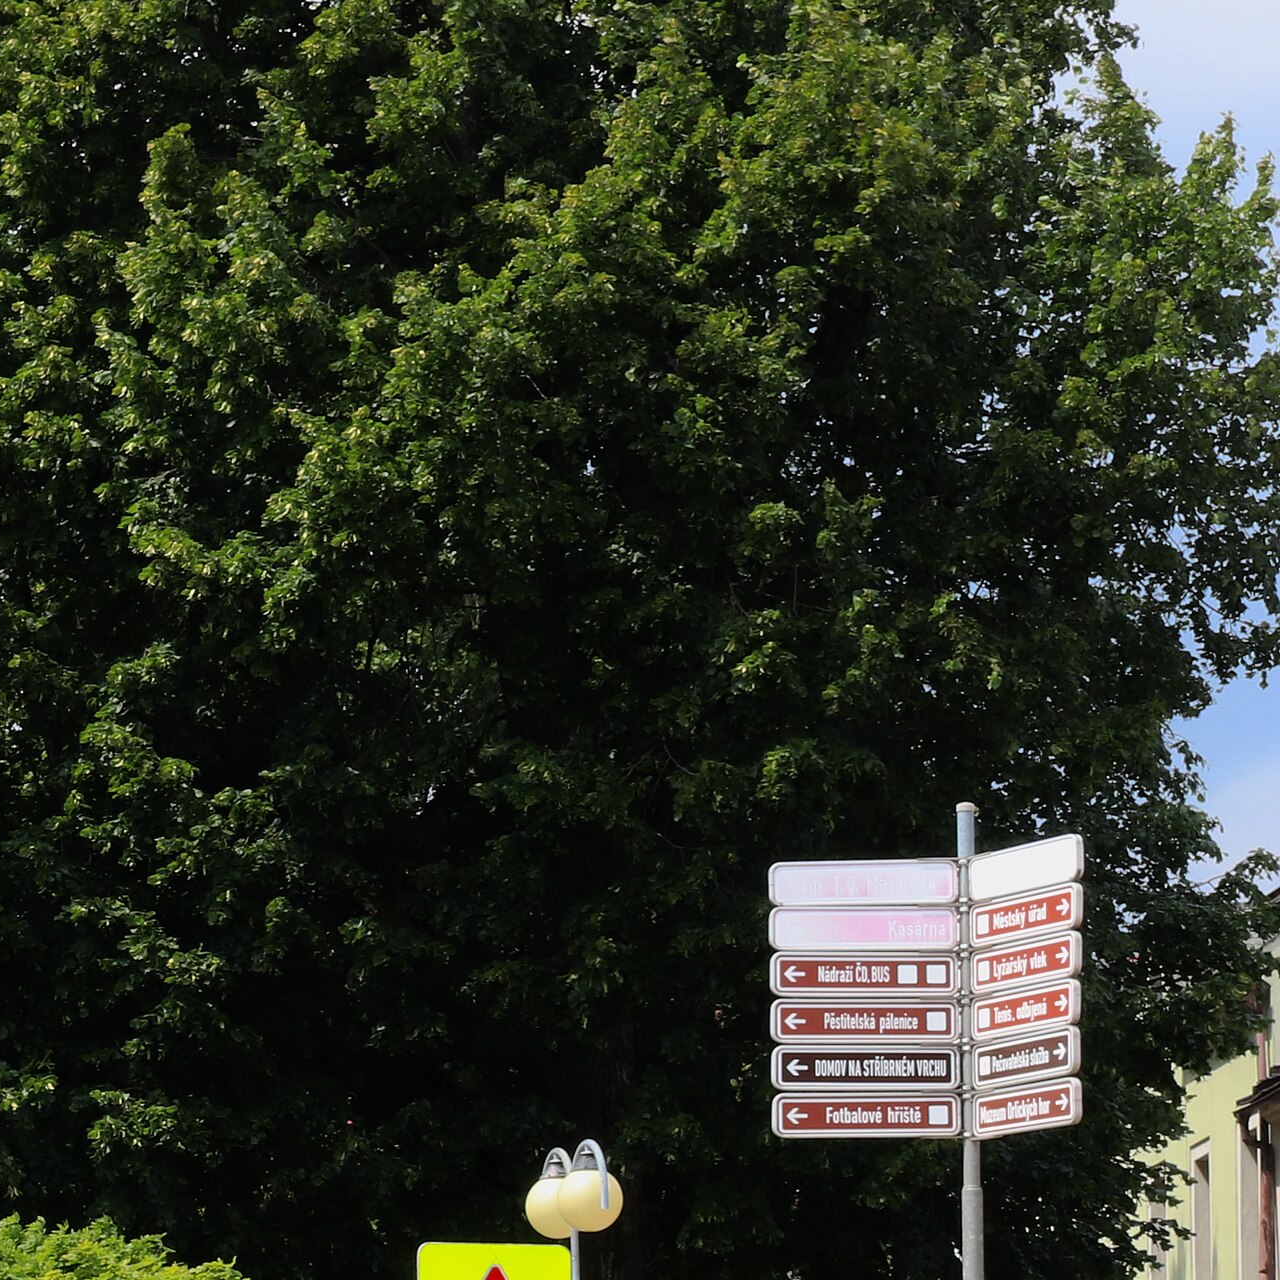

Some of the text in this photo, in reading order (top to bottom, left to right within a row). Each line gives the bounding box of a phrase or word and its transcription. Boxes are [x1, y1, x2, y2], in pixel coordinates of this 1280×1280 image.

[992, 902, 1047, 930] Městský úřad
[888, 920, 946, 937] Kasárna
[817, 965, 853, 983] Nádraží
[993, 950, 1048, 980] Lyžařský vlek
[823, 1012, 919, 1034] Pěstitelská pálenice
[814, 1055, 947, 1077] DOMOV NA STŘÍBRNÉM VRCHU
[825, 1105, 922, 1124] Fotbalové hřiště
[979, 1096, 1051, 1124] Muzeum Orlických hor
